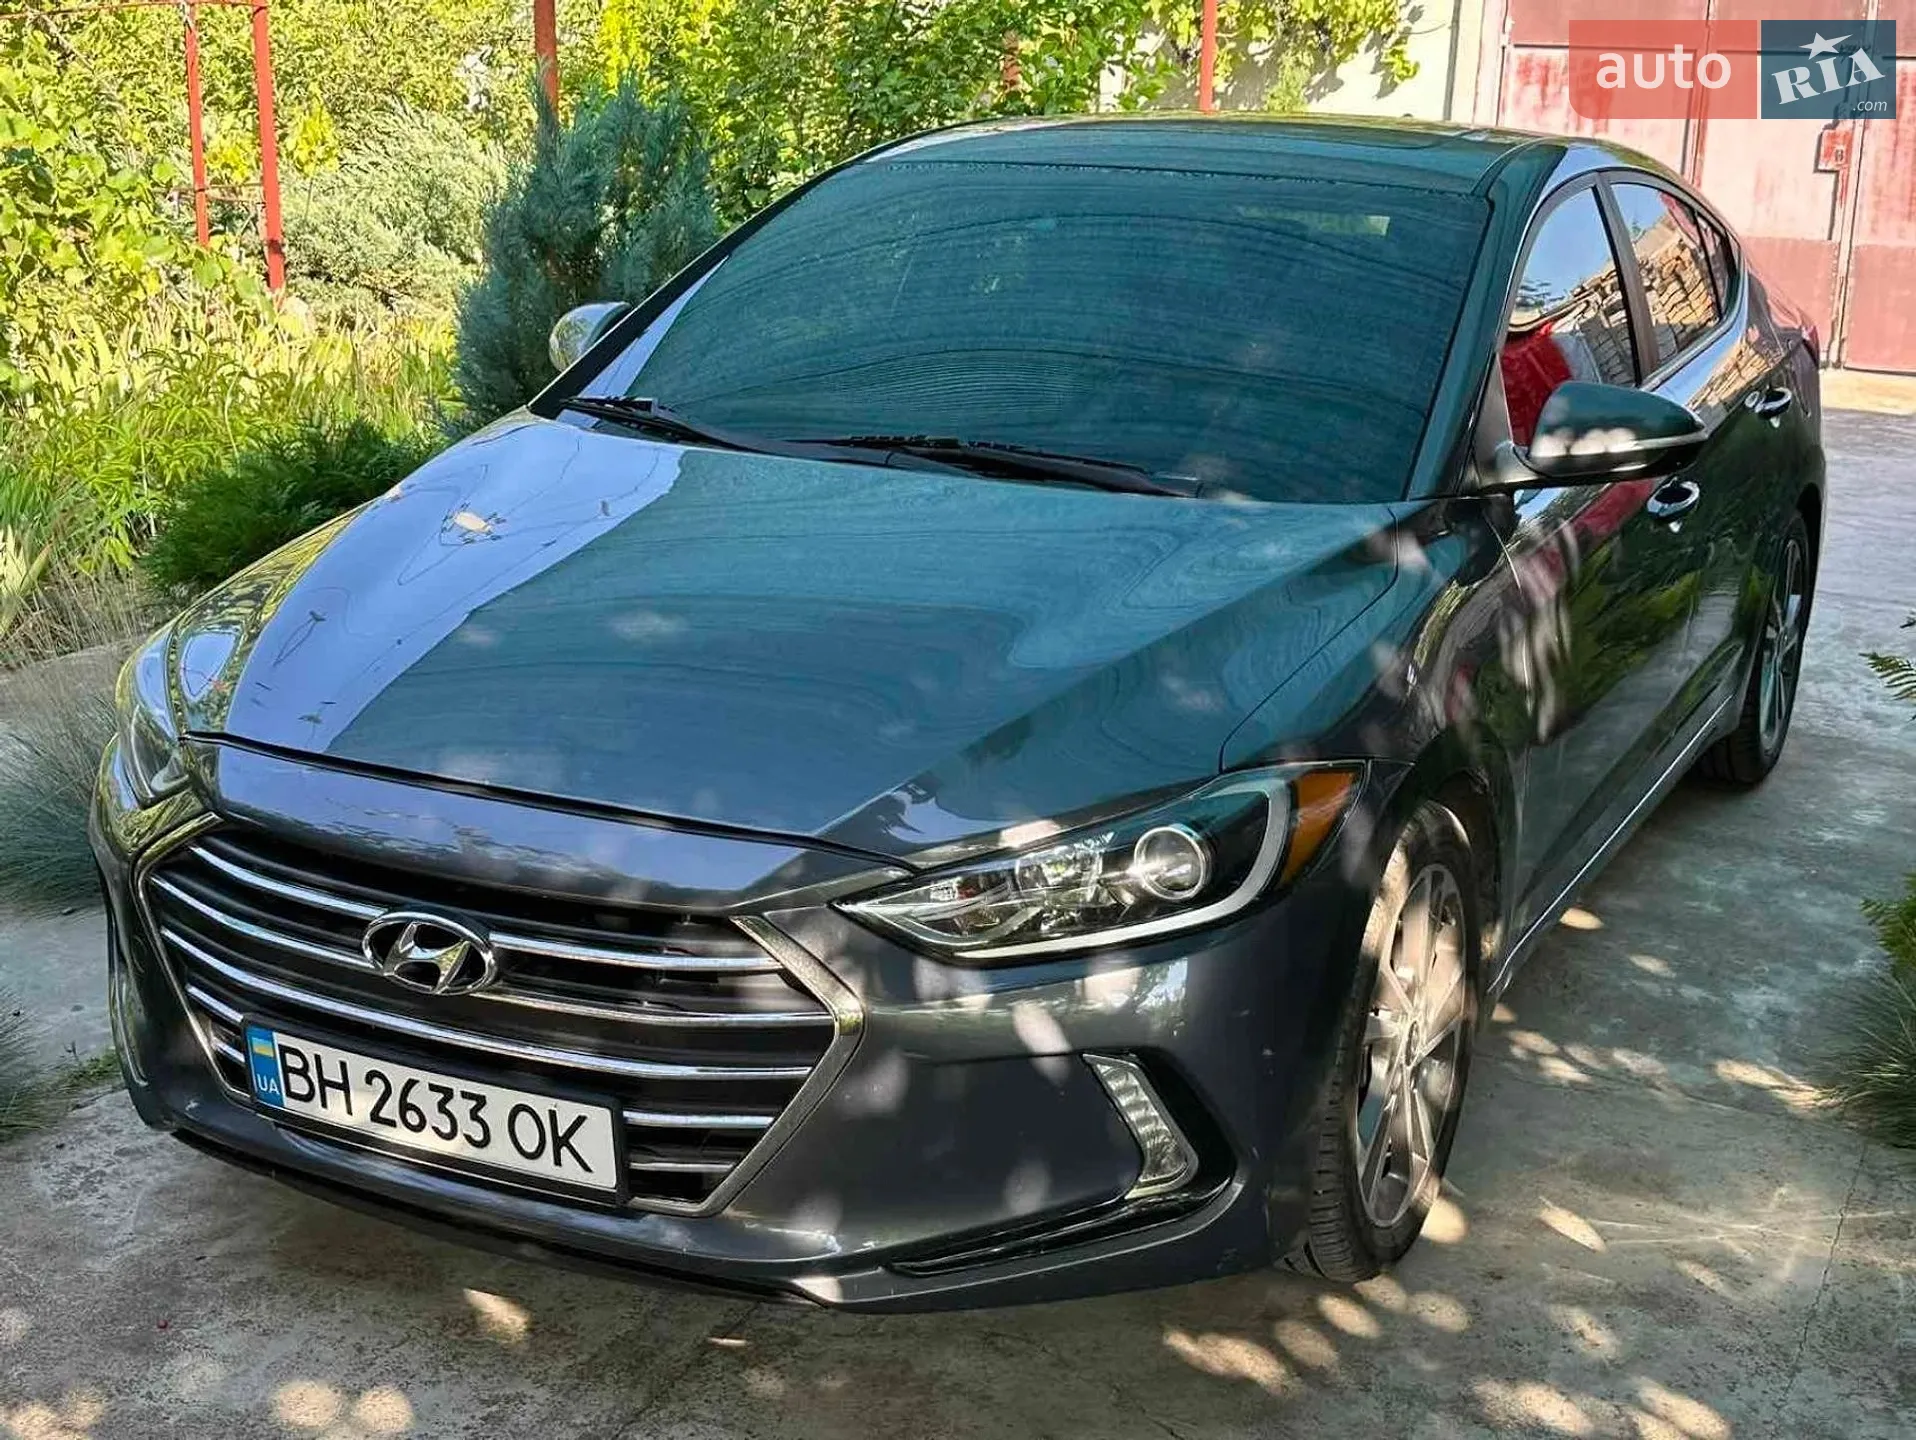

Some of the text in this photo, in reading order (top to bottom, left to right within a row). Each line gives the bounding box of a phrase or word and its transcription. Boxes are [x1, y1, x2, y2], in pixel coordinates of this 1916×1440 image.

[257, 1073, 280, 1095] UA
[279, 1043, 593, 1174] BH 2633 OK
